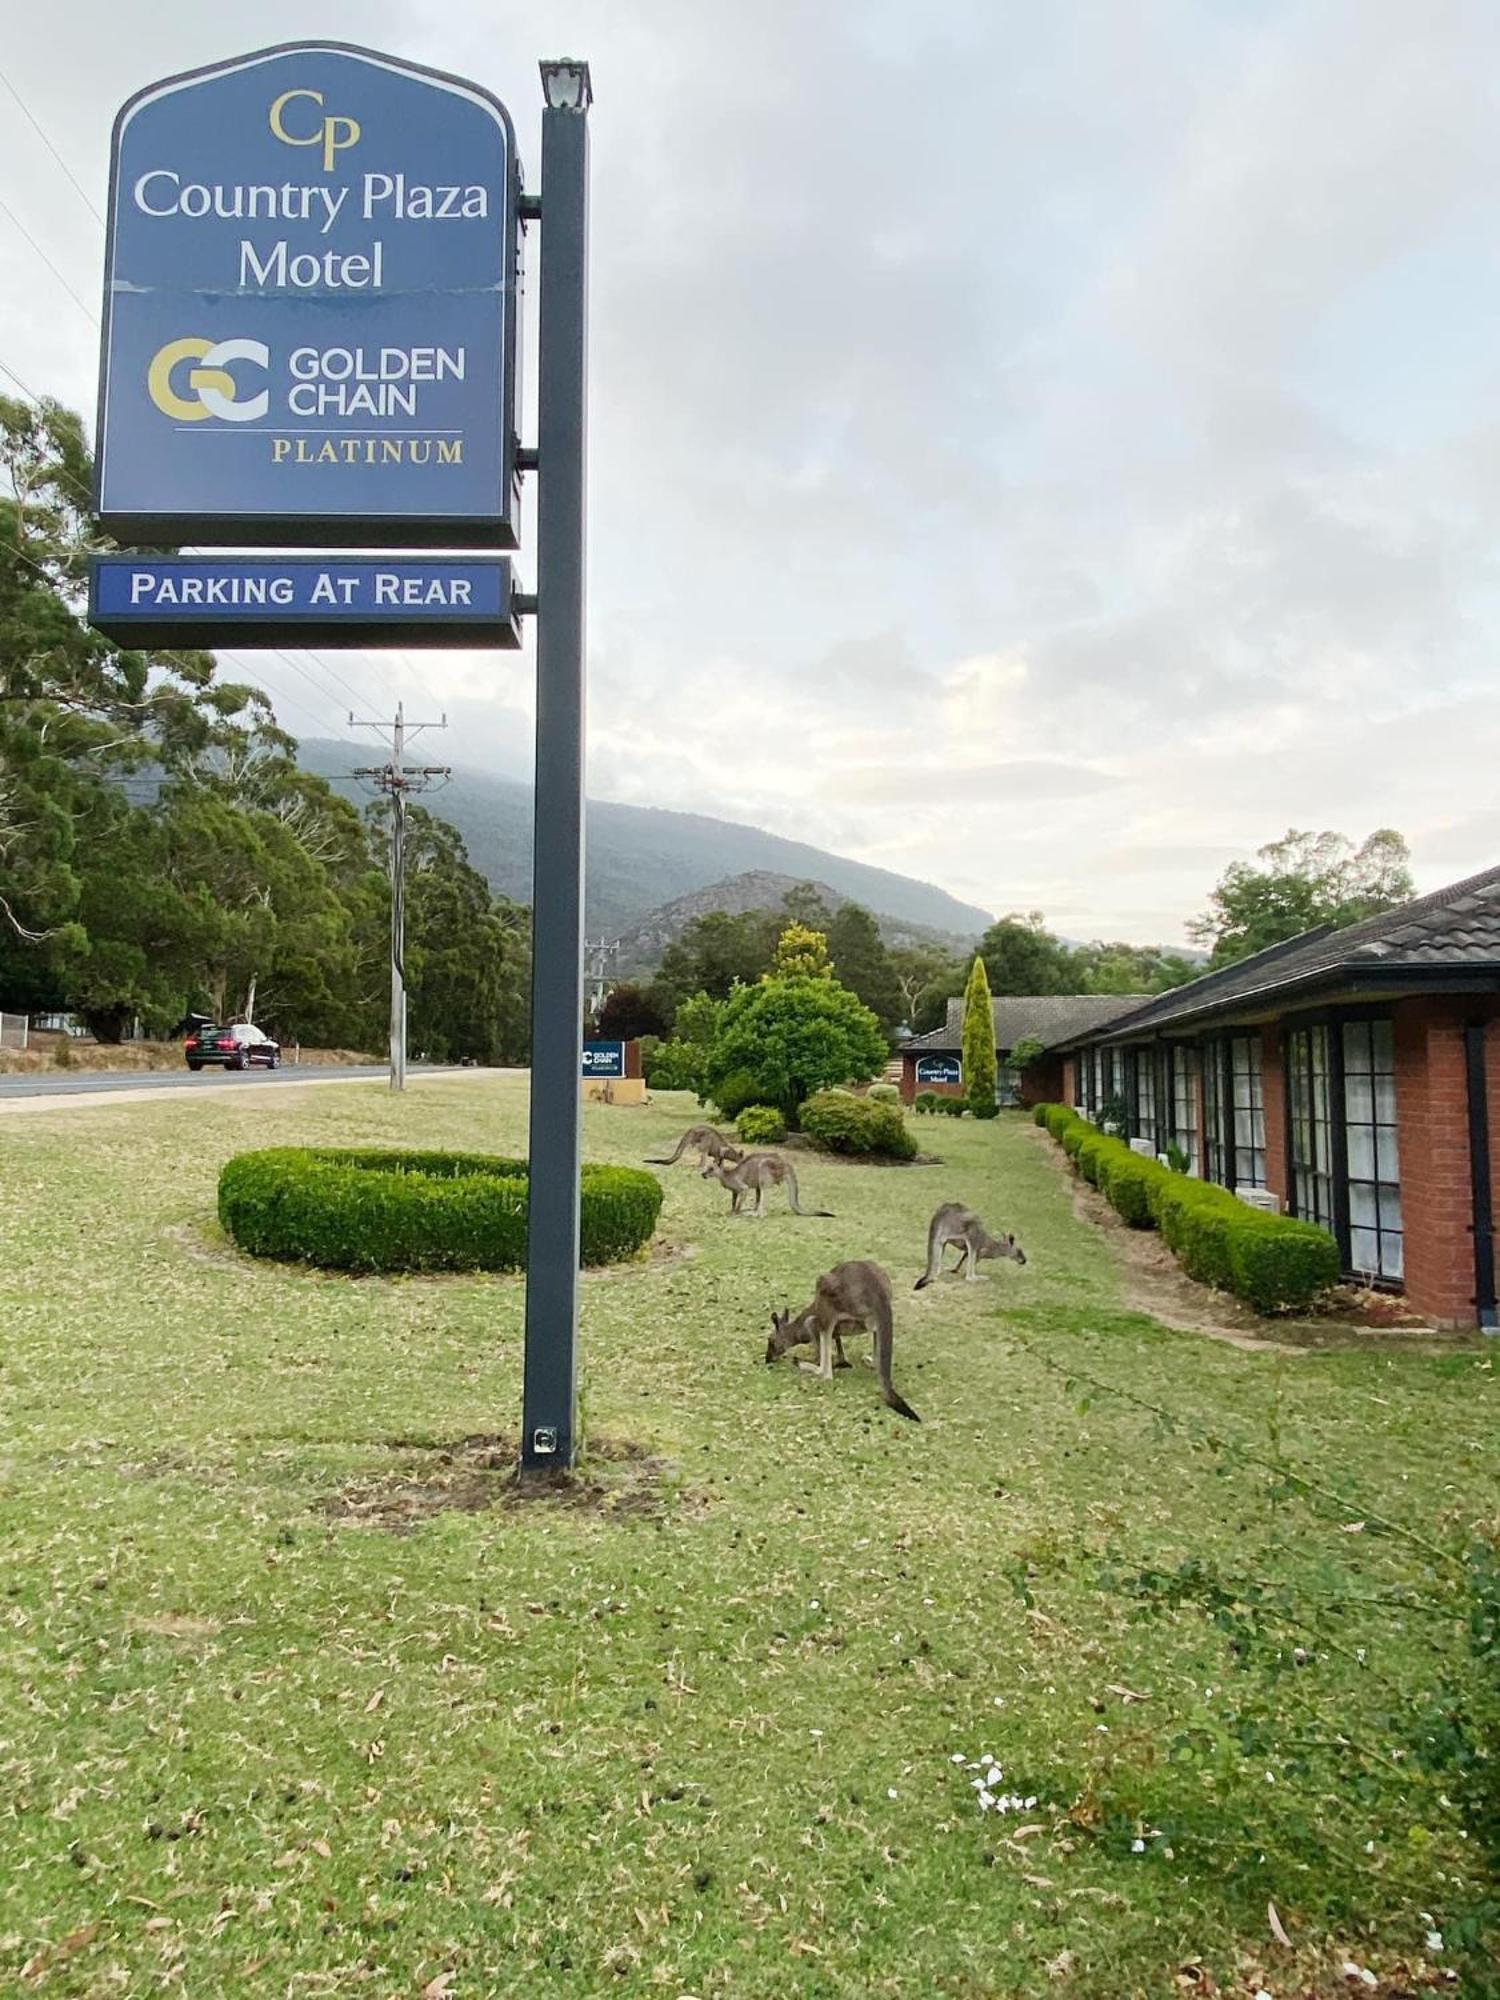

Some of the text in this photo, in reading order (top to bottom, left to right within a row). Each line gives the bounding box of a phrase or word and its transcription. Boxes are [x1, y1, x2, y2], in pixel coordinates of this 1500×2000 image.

[133, 169, 489, 234] Country Plaza
[239, 240, 383, 289] Motel
[288, 346, 465, 382] GOLDEN
[288, 383, 417, 417] CHAIN
[271, 439, 464, 465] PLATINUM
